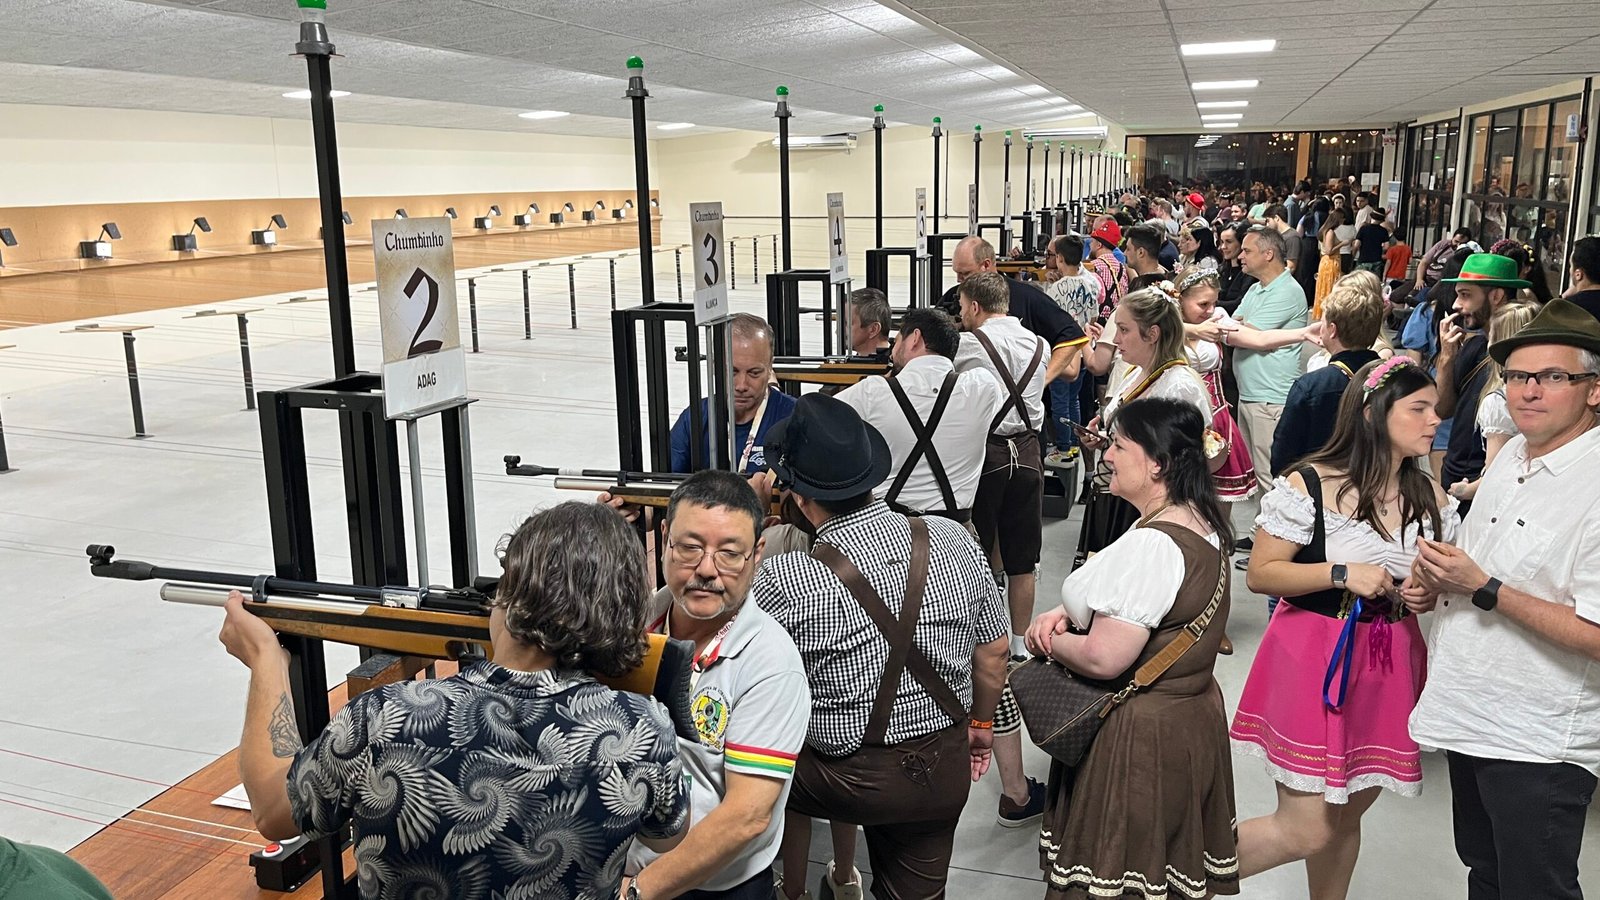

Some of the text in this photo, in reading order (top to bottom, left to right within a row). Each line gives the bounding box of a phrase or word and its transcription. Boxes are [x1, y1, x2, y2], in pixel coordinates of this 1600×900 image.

[385, 232, 444, 251] Chumbinho
[703, 232, 719, 289] 3
[403, 267, 443, 359] 2
[417, 371, 437, 389] ADAG
